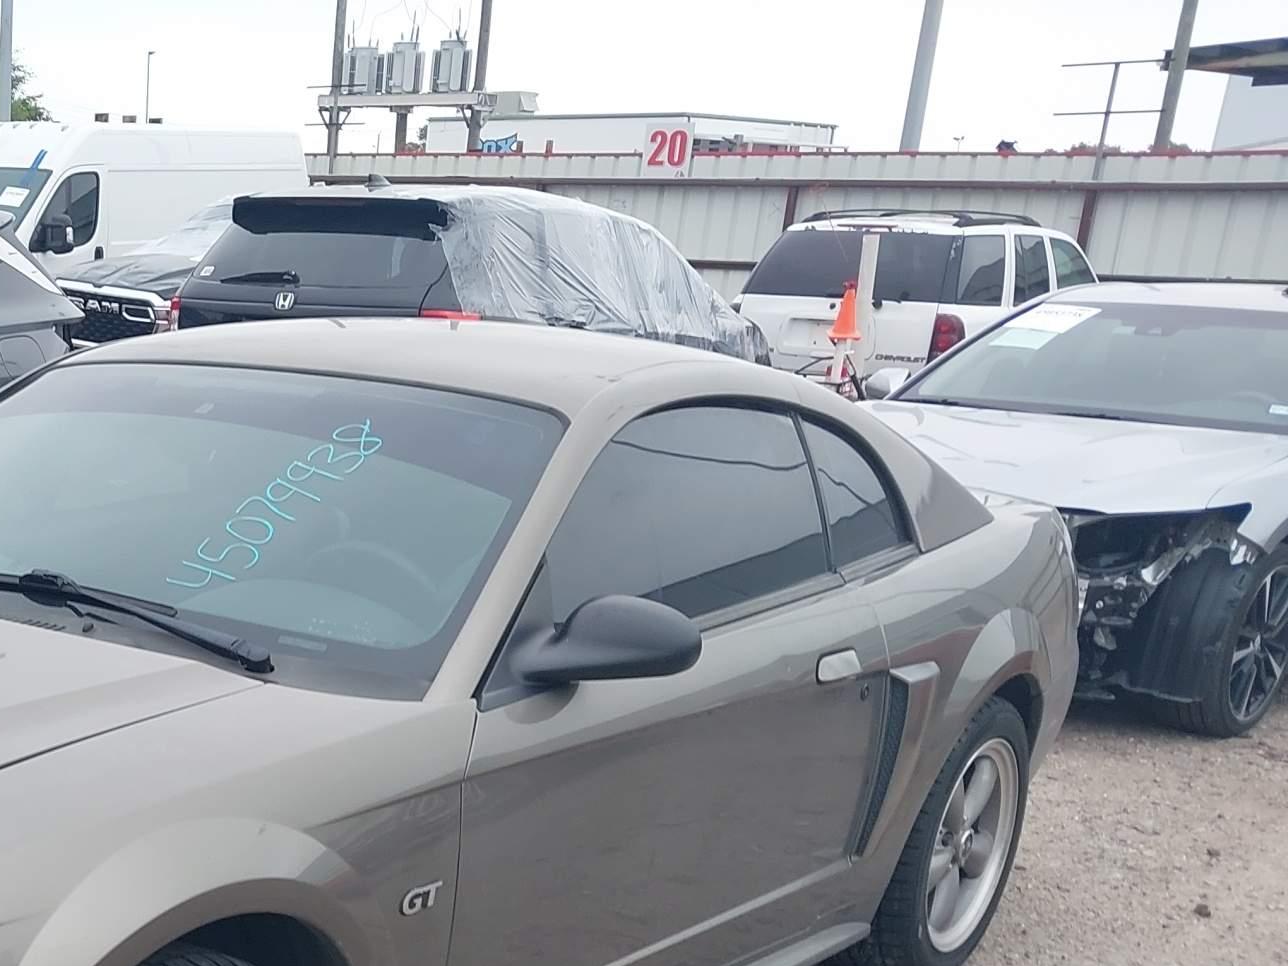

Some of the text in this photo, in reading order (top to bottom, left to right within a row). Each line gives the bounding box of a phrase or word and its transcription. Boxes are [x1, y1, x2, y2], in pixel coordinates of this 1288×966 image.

[647, 130, 688, 168] 20
[875, 354, 926, 363] CHEVROLET
[166, 418, 383, 588] 45079938
[400, 880, 443, 916] GT
